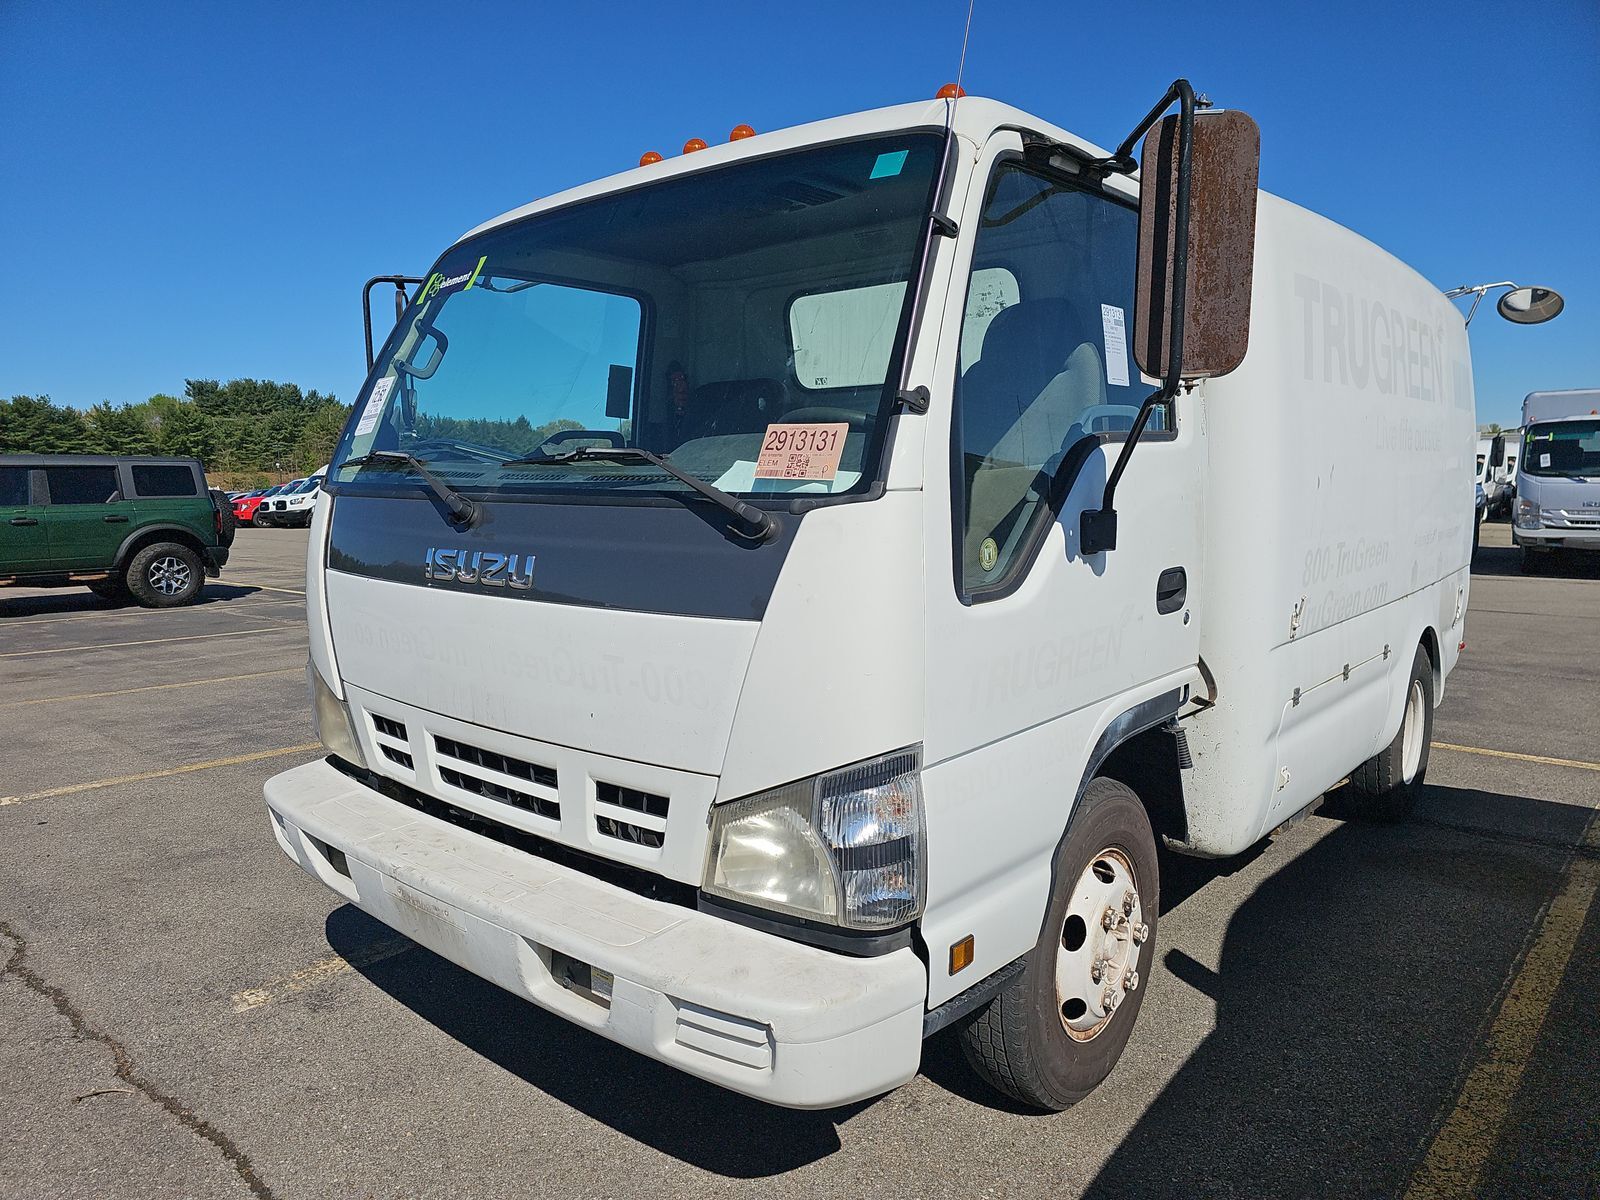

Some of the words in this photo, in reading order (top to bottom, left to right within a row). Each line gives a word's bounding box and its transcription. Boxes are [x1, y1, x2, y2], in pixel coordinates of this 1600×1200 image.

[1294, 272, 1444, 403] TRUGREEN
[758, 459, 779, 467] ELEM
[765, 430, 838, 451] 2913131
[425, 547, 535, 590] ISUZU
[1302, 536, 1389, 588] 800-TruGreen
[965, 625, 1124, 714] TRUGREEN
